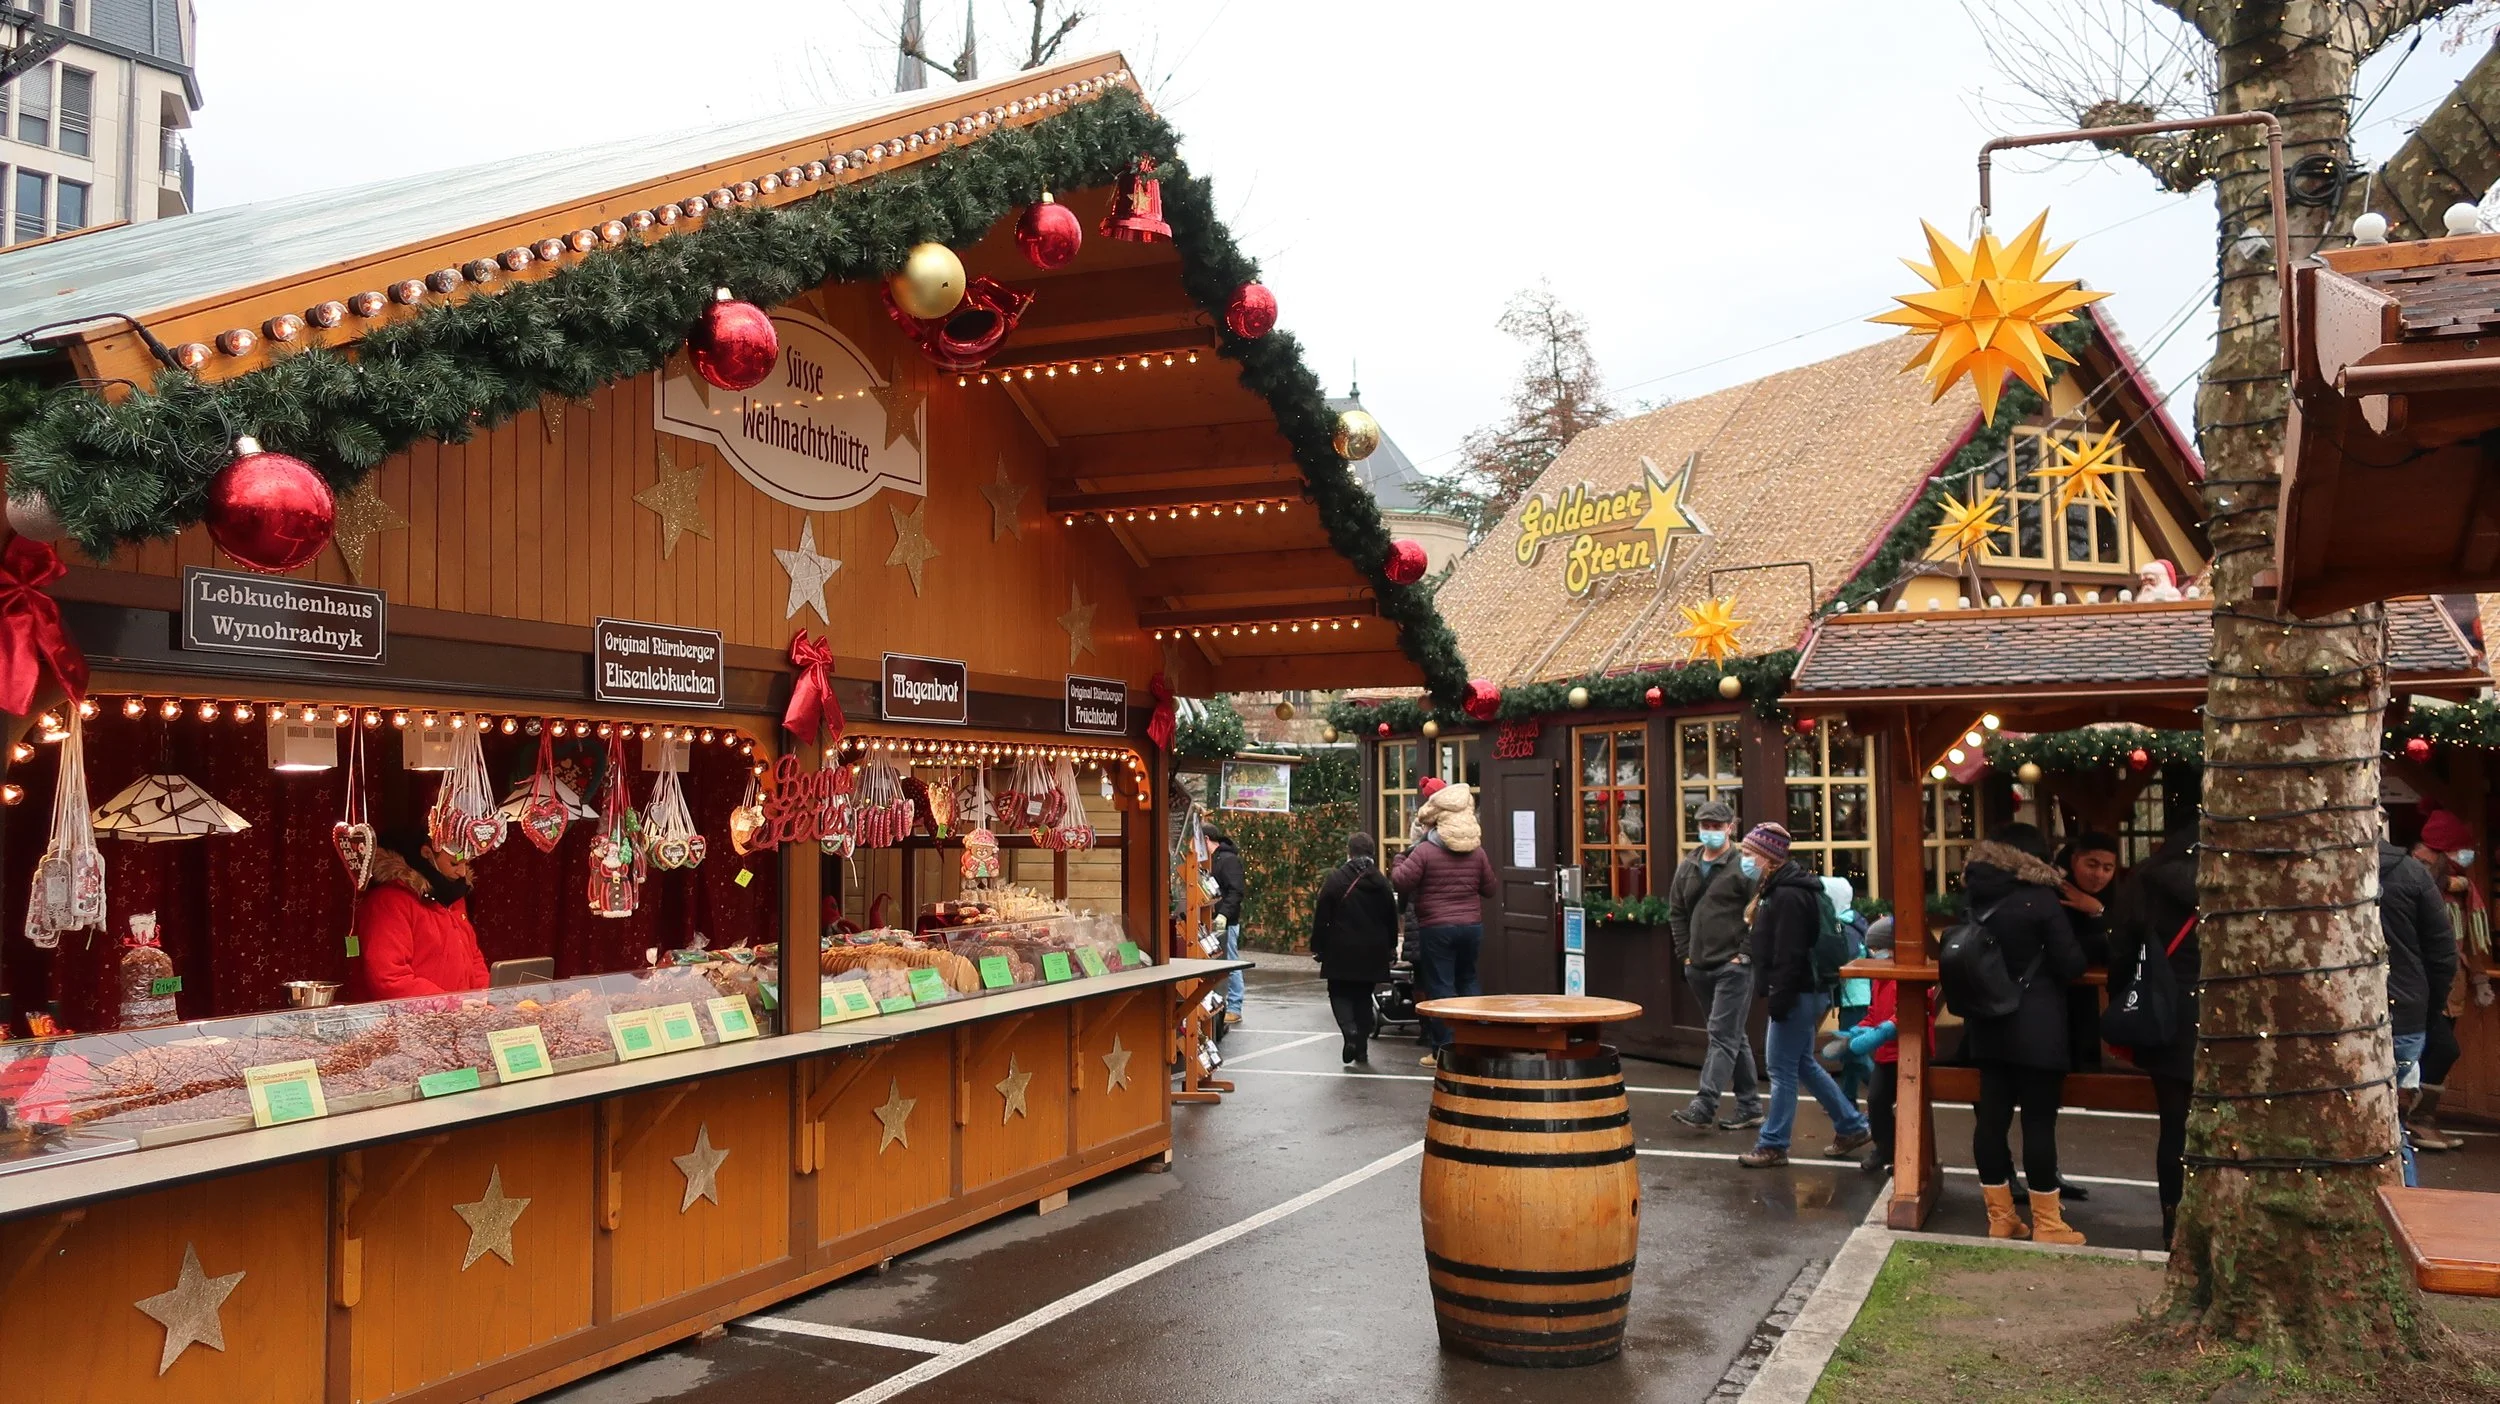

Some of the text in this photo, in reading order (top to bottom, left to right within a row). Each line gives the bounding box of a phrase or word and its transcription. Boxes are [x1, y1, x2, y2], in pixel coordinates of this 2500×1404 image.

[786, 345, 824, 395] Süsse
[743, 396, 869, 473] Weihnachtshütte
[1516, 487, 1643, 562] Goldener
[1566, 534, 1650, 592] Stern
[200, 581, 373, 619] Lebkuchenhaus
[211, 615, 364, 651] Wynohradnyk
[605, 632, 715, 663] Original Nürnberger
[605, 662, 716, 694] Elisenlebkuchen
[892, 673, 959, 705] Magenbrot
[1070, 684, 1093, 701] Original
[1075, 705, 1118, 726] Früchtebrot
[772, 753, 856, 803] Bonnes
